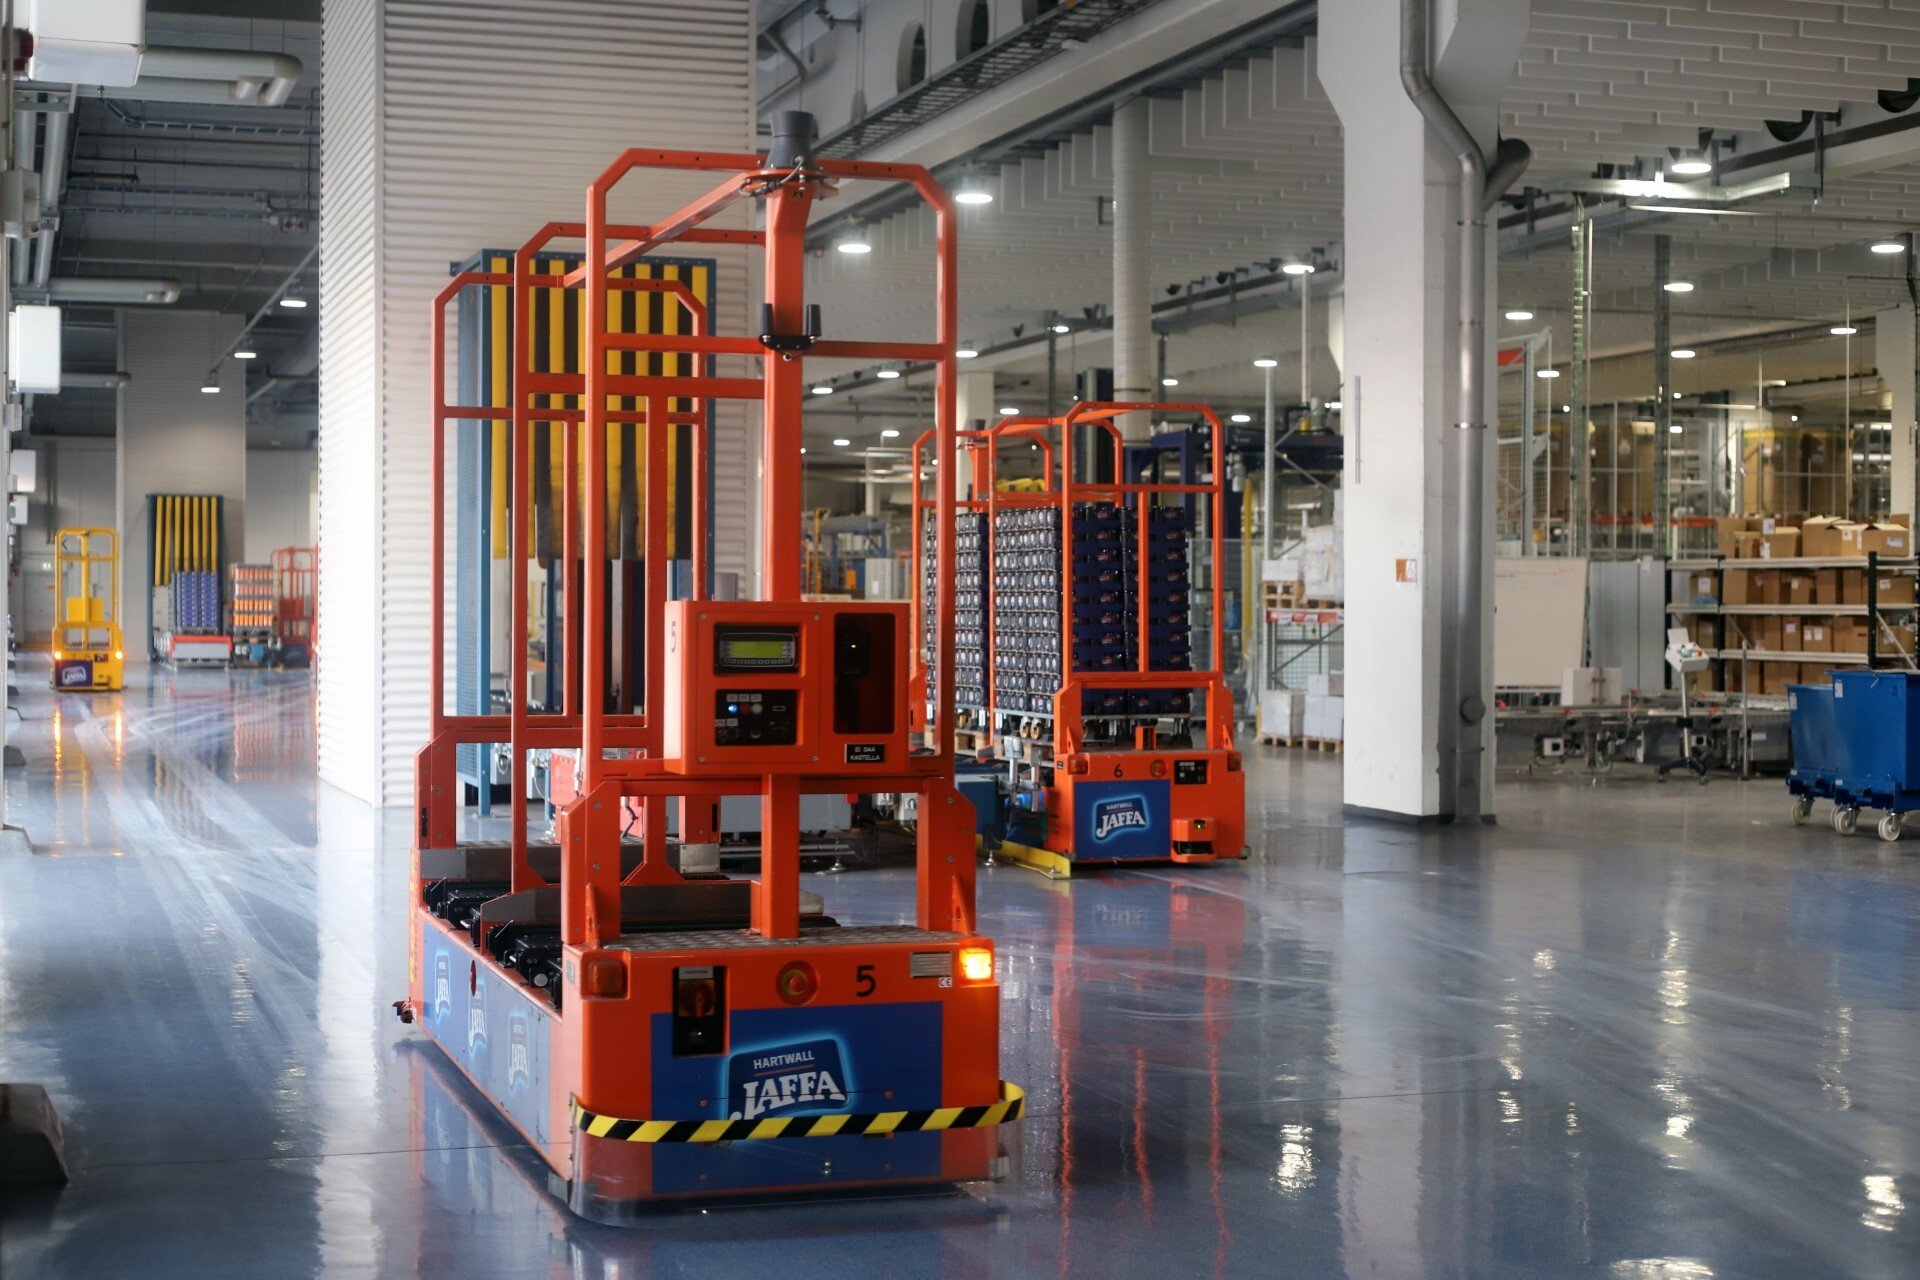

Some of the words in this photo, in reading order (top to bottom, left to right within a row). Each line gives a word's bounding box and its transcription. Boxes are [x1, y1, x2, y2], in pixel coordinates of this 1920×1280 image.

[1114, 764, 1123, 778] 6
[1106, 801, 1133, 810] HARTWALL
[1096, 811, 1146, 837] JAFFA
[856, 965, 876, 998] 5
[753, 1050, 815, 1070] HARTWALL
[729, 1070, 846, 1121] JAFFA
